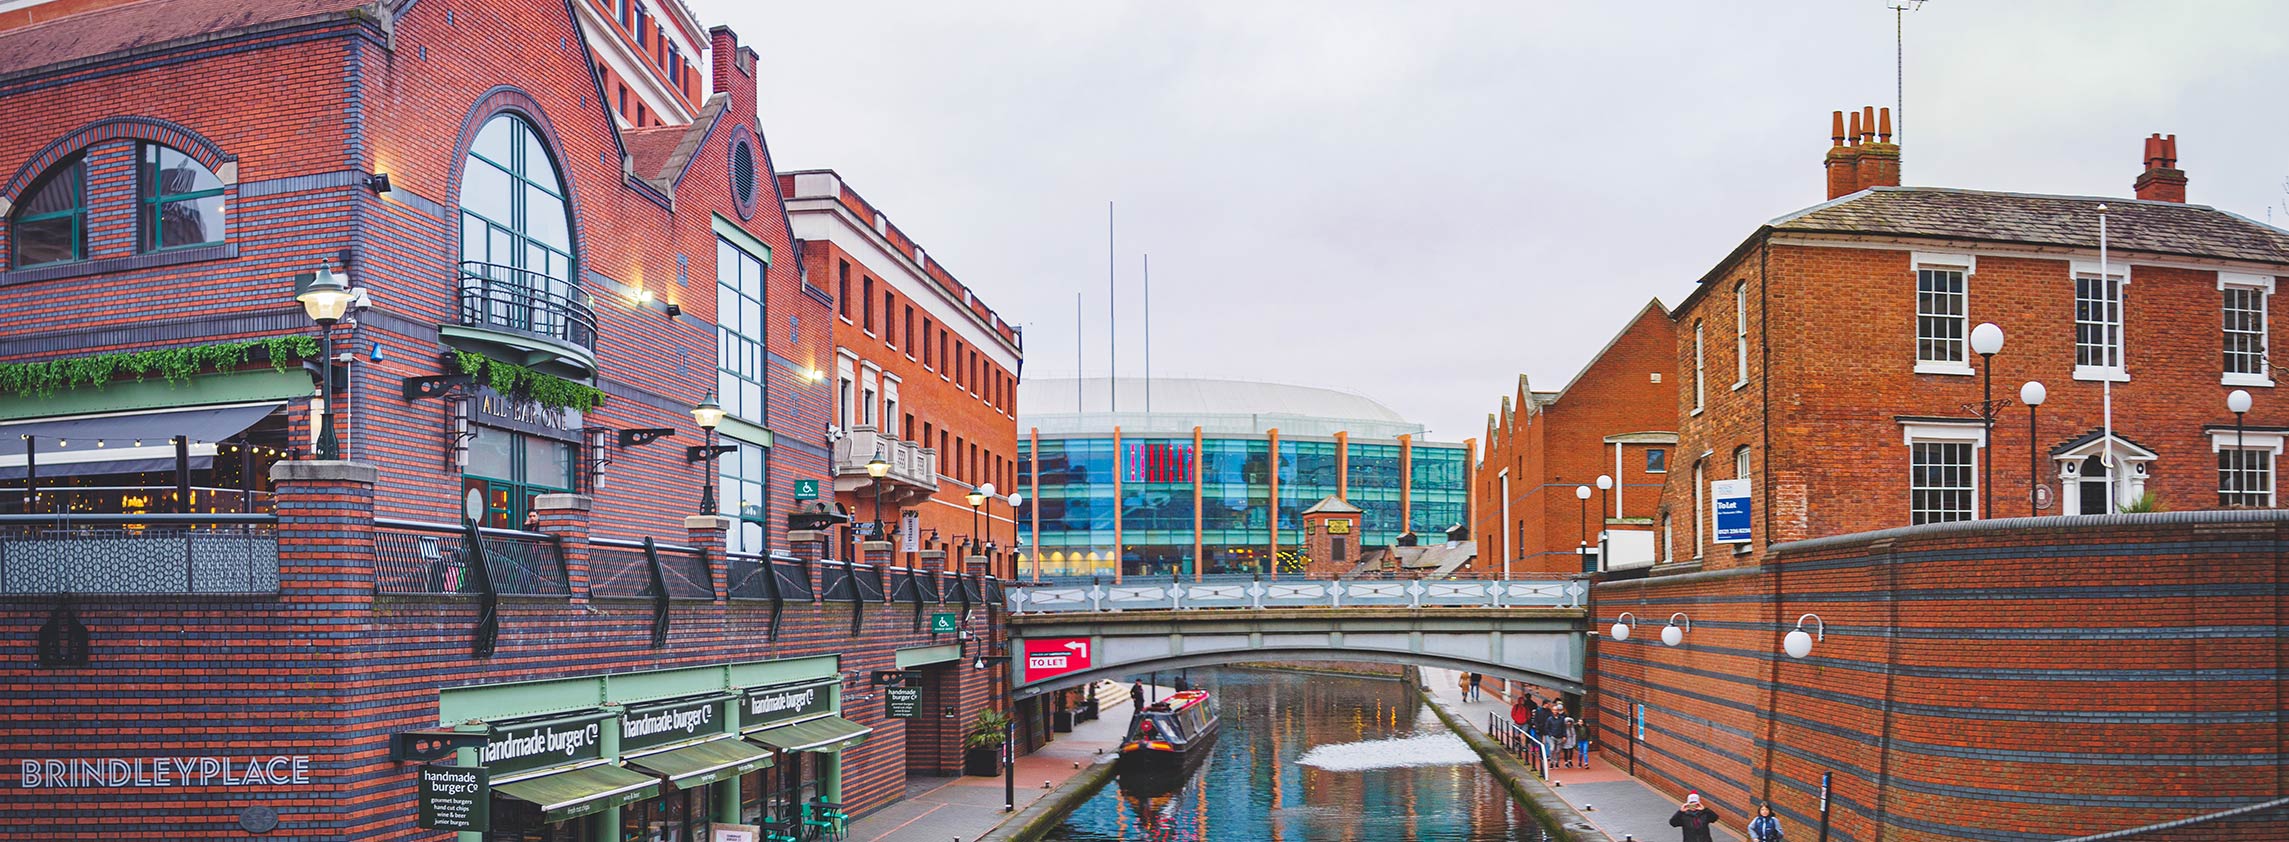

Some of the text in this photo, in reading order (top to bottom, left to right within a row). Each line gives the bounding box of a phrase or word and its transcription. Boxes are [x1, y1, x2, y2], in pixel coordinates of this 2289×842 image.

[482, 395, 568, 431] ALL BAR ONE
[1031, 659, 1064, 667] TO LET
[752, 693, 785, 715] handmade
[785, 692, 806, 713] burger
[892, 694, 910, 702] burger
[624, 710, 673, 739] handmade
[673, 709, 702, 734] burger
[547, 727, 585, 756] burger
[21, 755, 310, 788] BRINDLEYPLACE
[424, 770, 477, 783] handmade
[432, 780, 466, 795] burger
[434, 818, 470, 827] junior burgers
